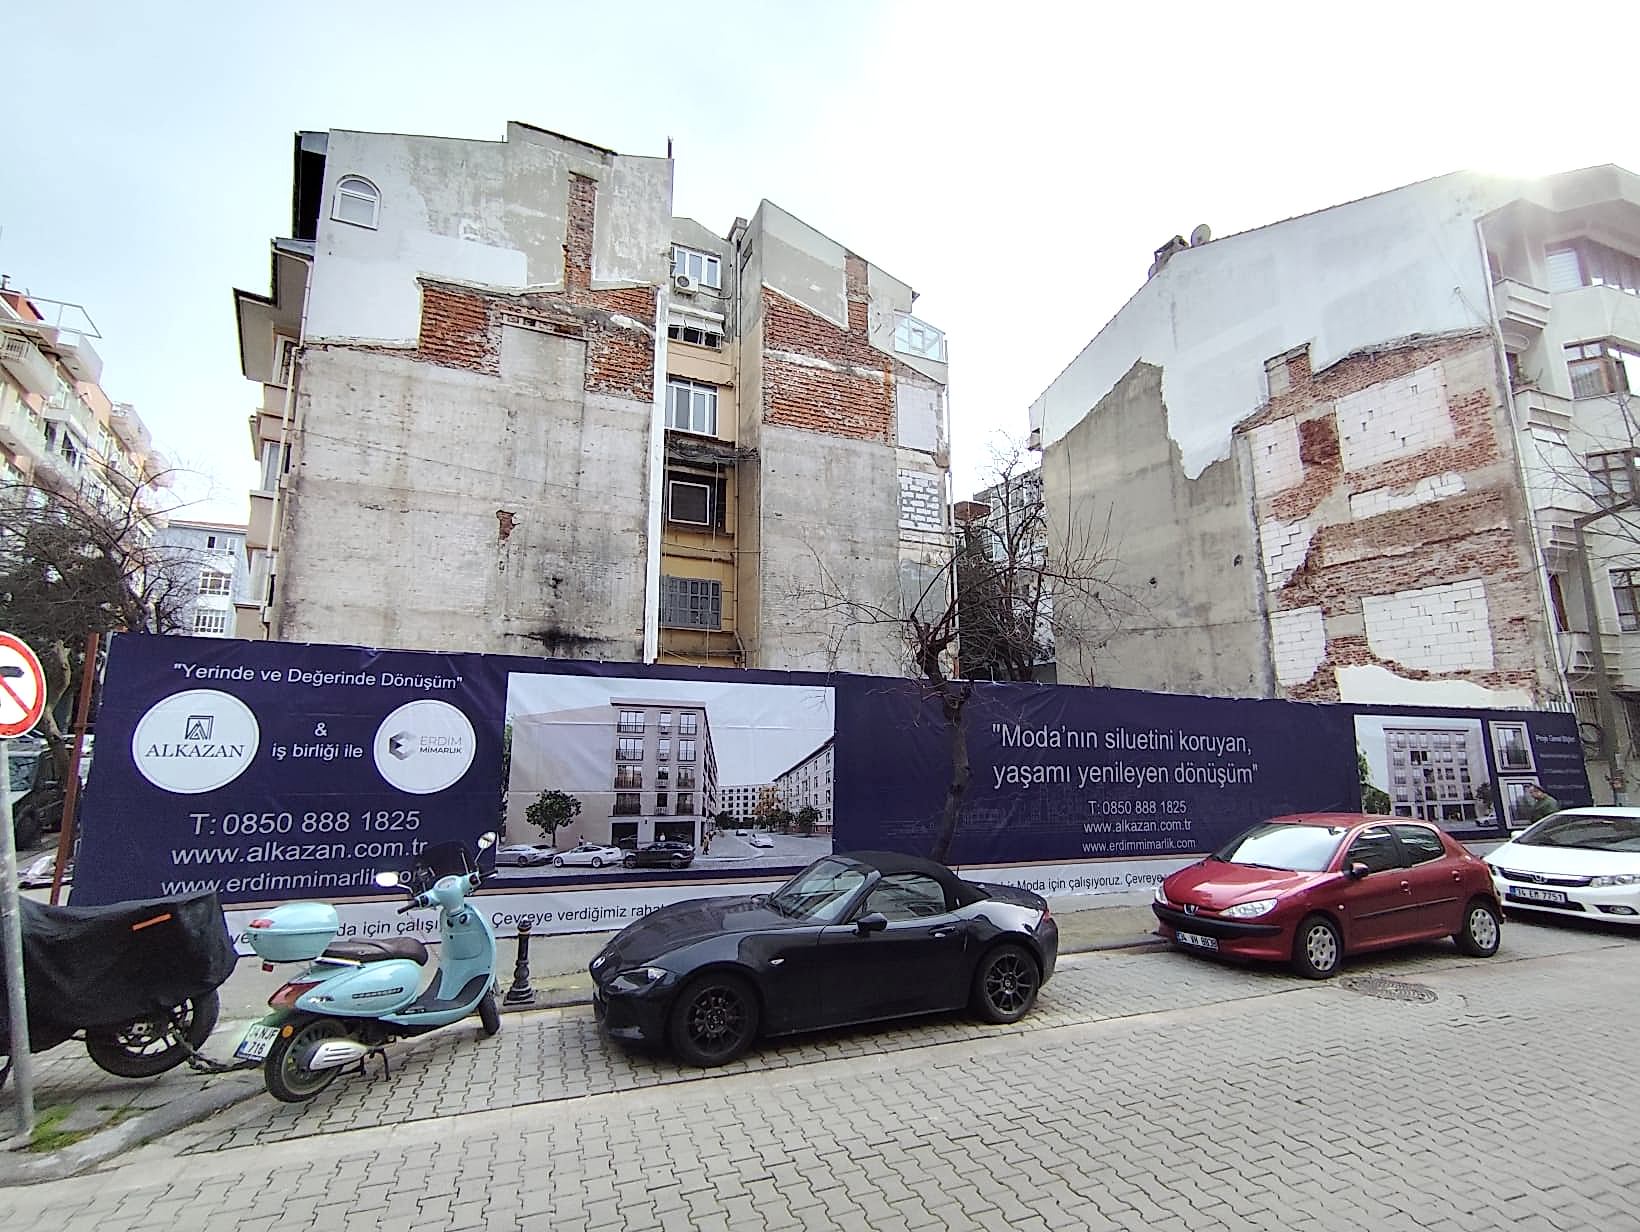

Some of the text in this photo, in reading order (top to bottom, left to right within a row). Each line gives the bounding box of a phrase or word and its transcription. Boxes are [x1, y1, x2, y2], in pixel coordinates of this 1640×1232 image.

[173, 663, 463, 691] "Yerinde ve Değerinde Dönüşüm"
[314, 722, 328, 737] &
[143, 743, 246, 758] ALKAZAN
[271, 743, 364, 761] iş birliği ile
[1104, 728, 1174, 750] siluetini
[1179, 730, 1252, 757] koruyan,
[992, 761, 1258, 789] yaşamı yenileyen dönüşüm"
[1087, 800, 1187, 816] T: 0850 888 1825
[189, 810, 421, 836] T: 0850 888 1825
[1083, 818, 1192, 833] www.alkazan.com.tr
[171, 837, 428, 866] www.alkazan.com.tr
[1082, 837, 1196, 853] www.erdimmimarlik.com
[1017, 879, 1046, 892] Moda
[1048, 876, 1067, 892] için
[1068, 875, 1124, 892] çalışıyoruz.
[1125, 872, 1164, 888] Çevreye
[363, 919, 391, 938] için
[491, 911, 553, 929] Çevreye
[557, 906, 627, 922] verdiğimiz
